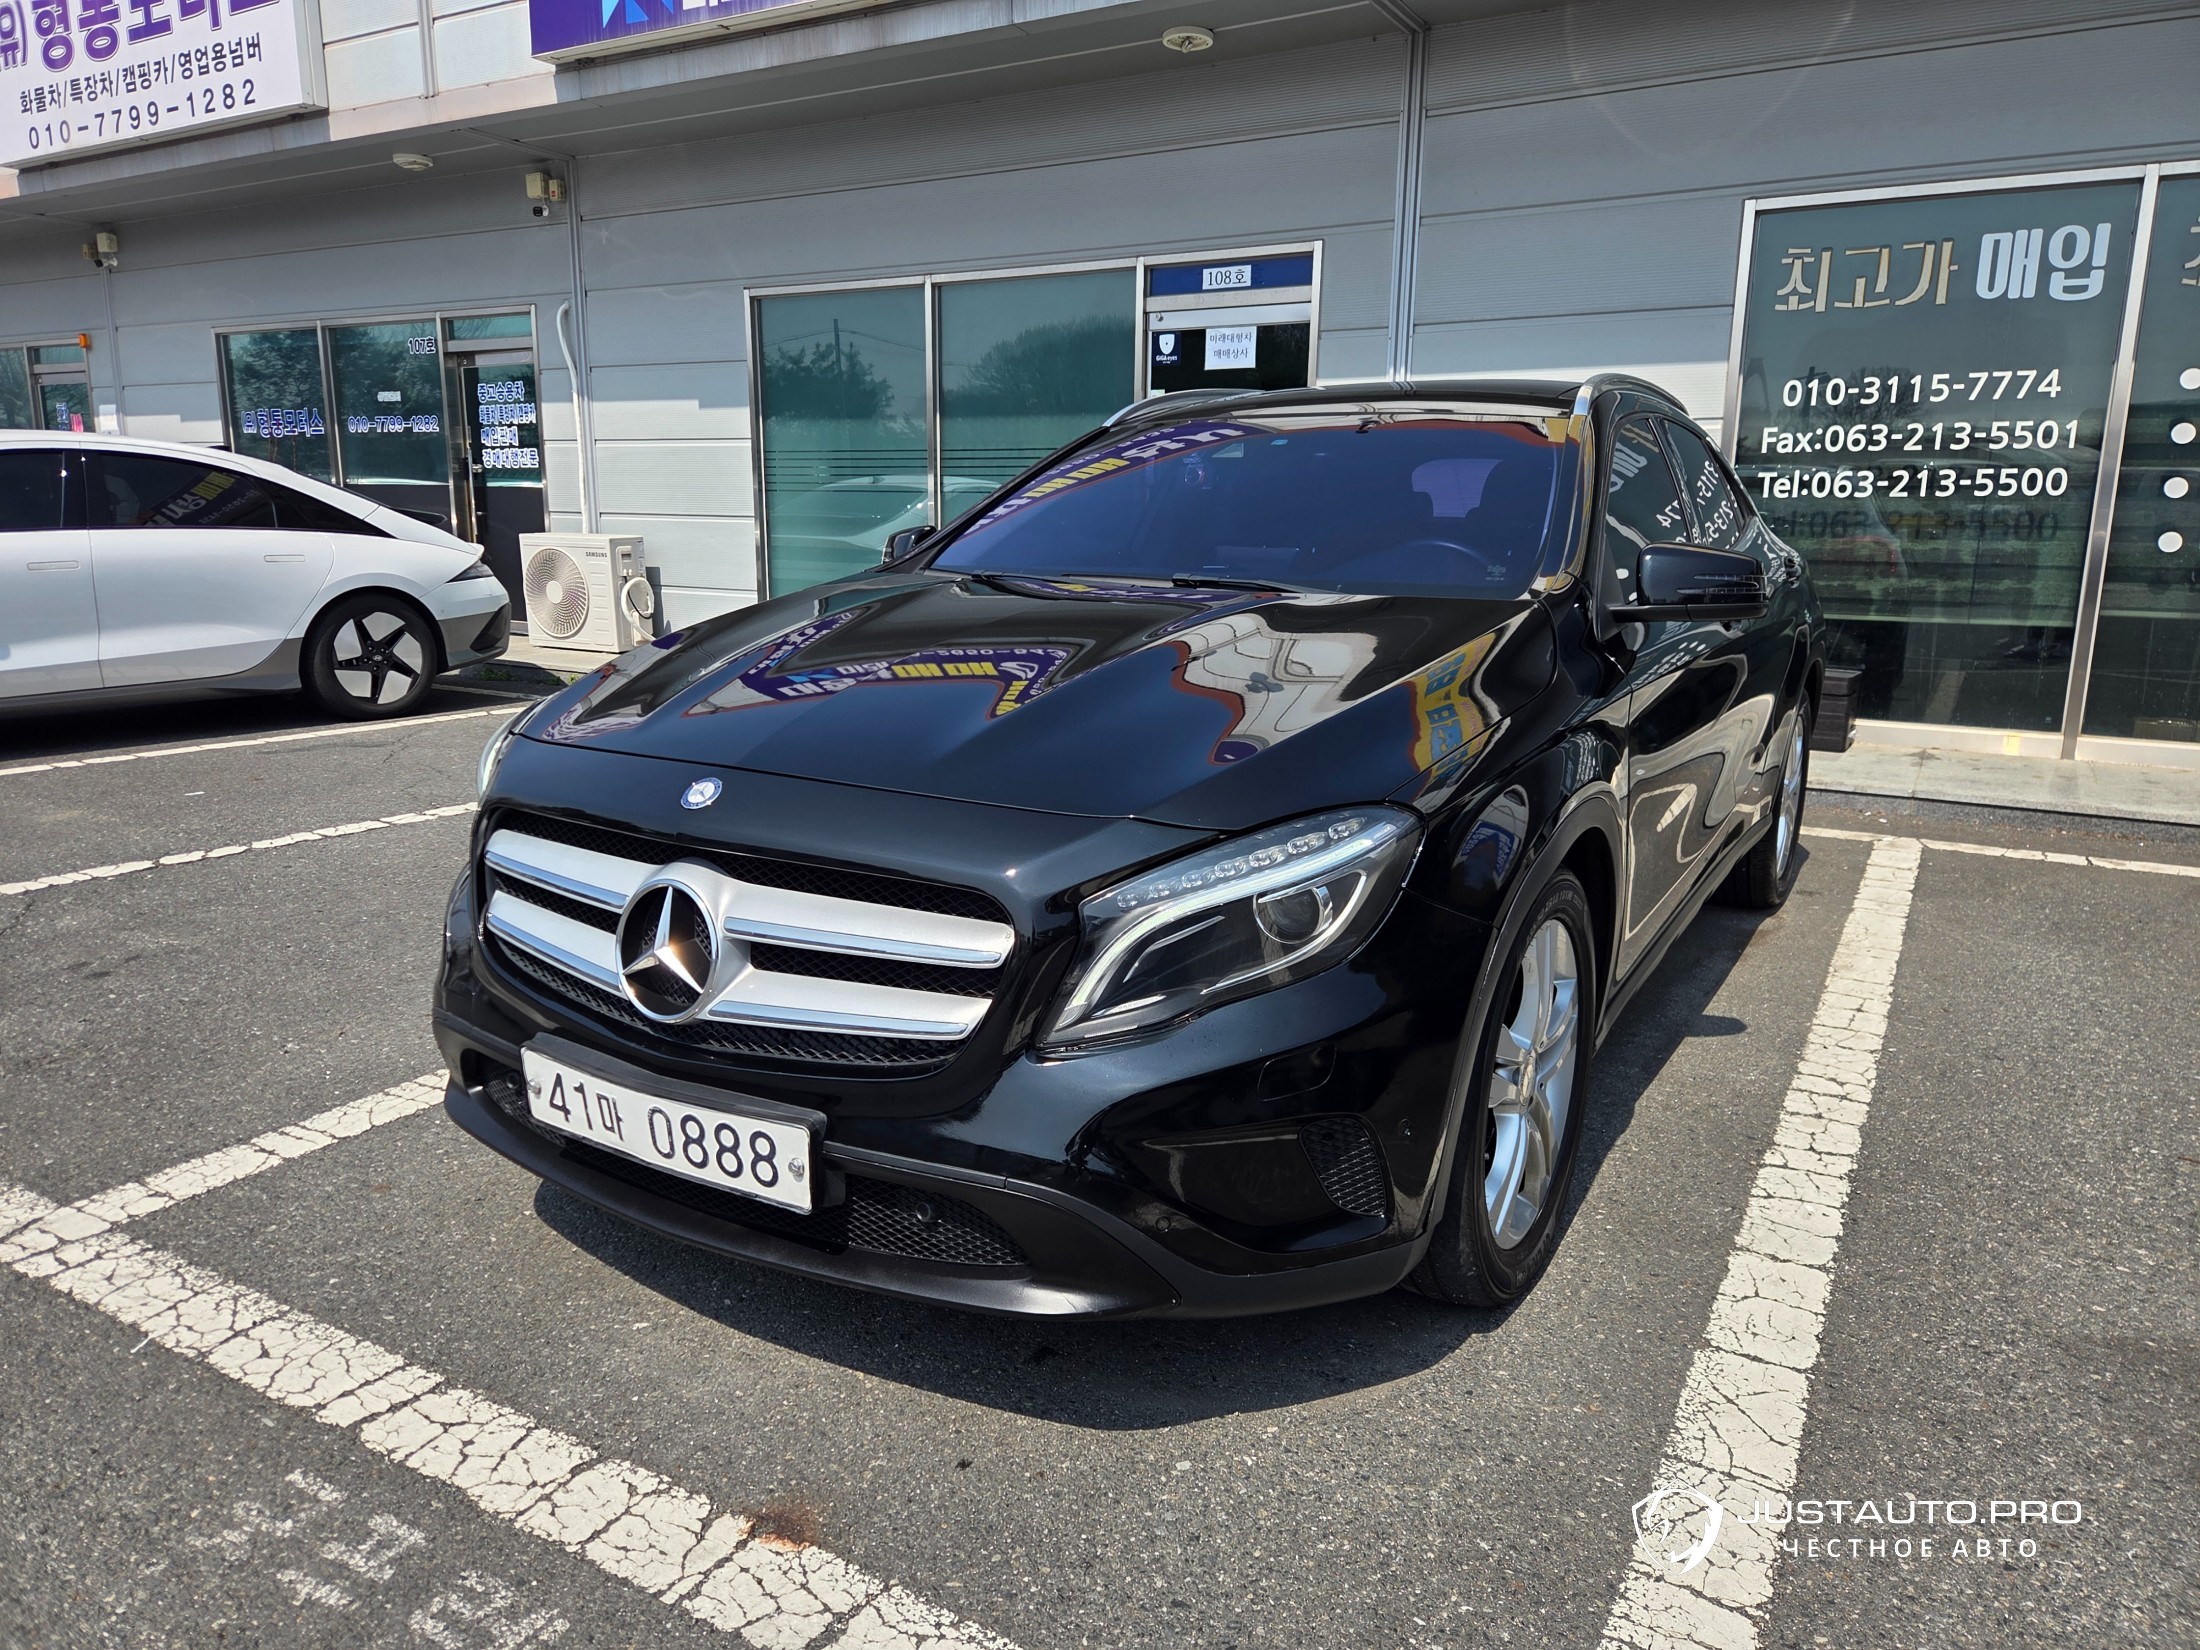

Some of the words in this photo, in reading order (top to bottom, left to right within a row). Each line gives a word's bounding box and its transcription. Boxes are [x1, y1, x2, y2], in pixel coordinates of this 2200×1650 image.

[20, 32, 263, 115] 화물차/특장차/캠핑카/영업용넘버
[28, 78, 256, 150] 010-7799-1282
[1208, 269, 1247, 286] 108호
[1774, 238, 1959, 312] 최고가
[1975, 223, 2111, 301] 매입
[408, 336, 436, 354] 107호
[477, 380, 525, 403] 중고승용차
[1783, 368, 2062, 407] 010-3115-7774
[348, 415, 439, 433] 010-7799-1282
[1761, 420, 2078, 454] Fax:063-213-5501
[1758, 467, 2068, 498] Tel:063-213-5500
[549, 1072, 624, 1142] 41마
[648, 1106, 779, 1188] 0888
